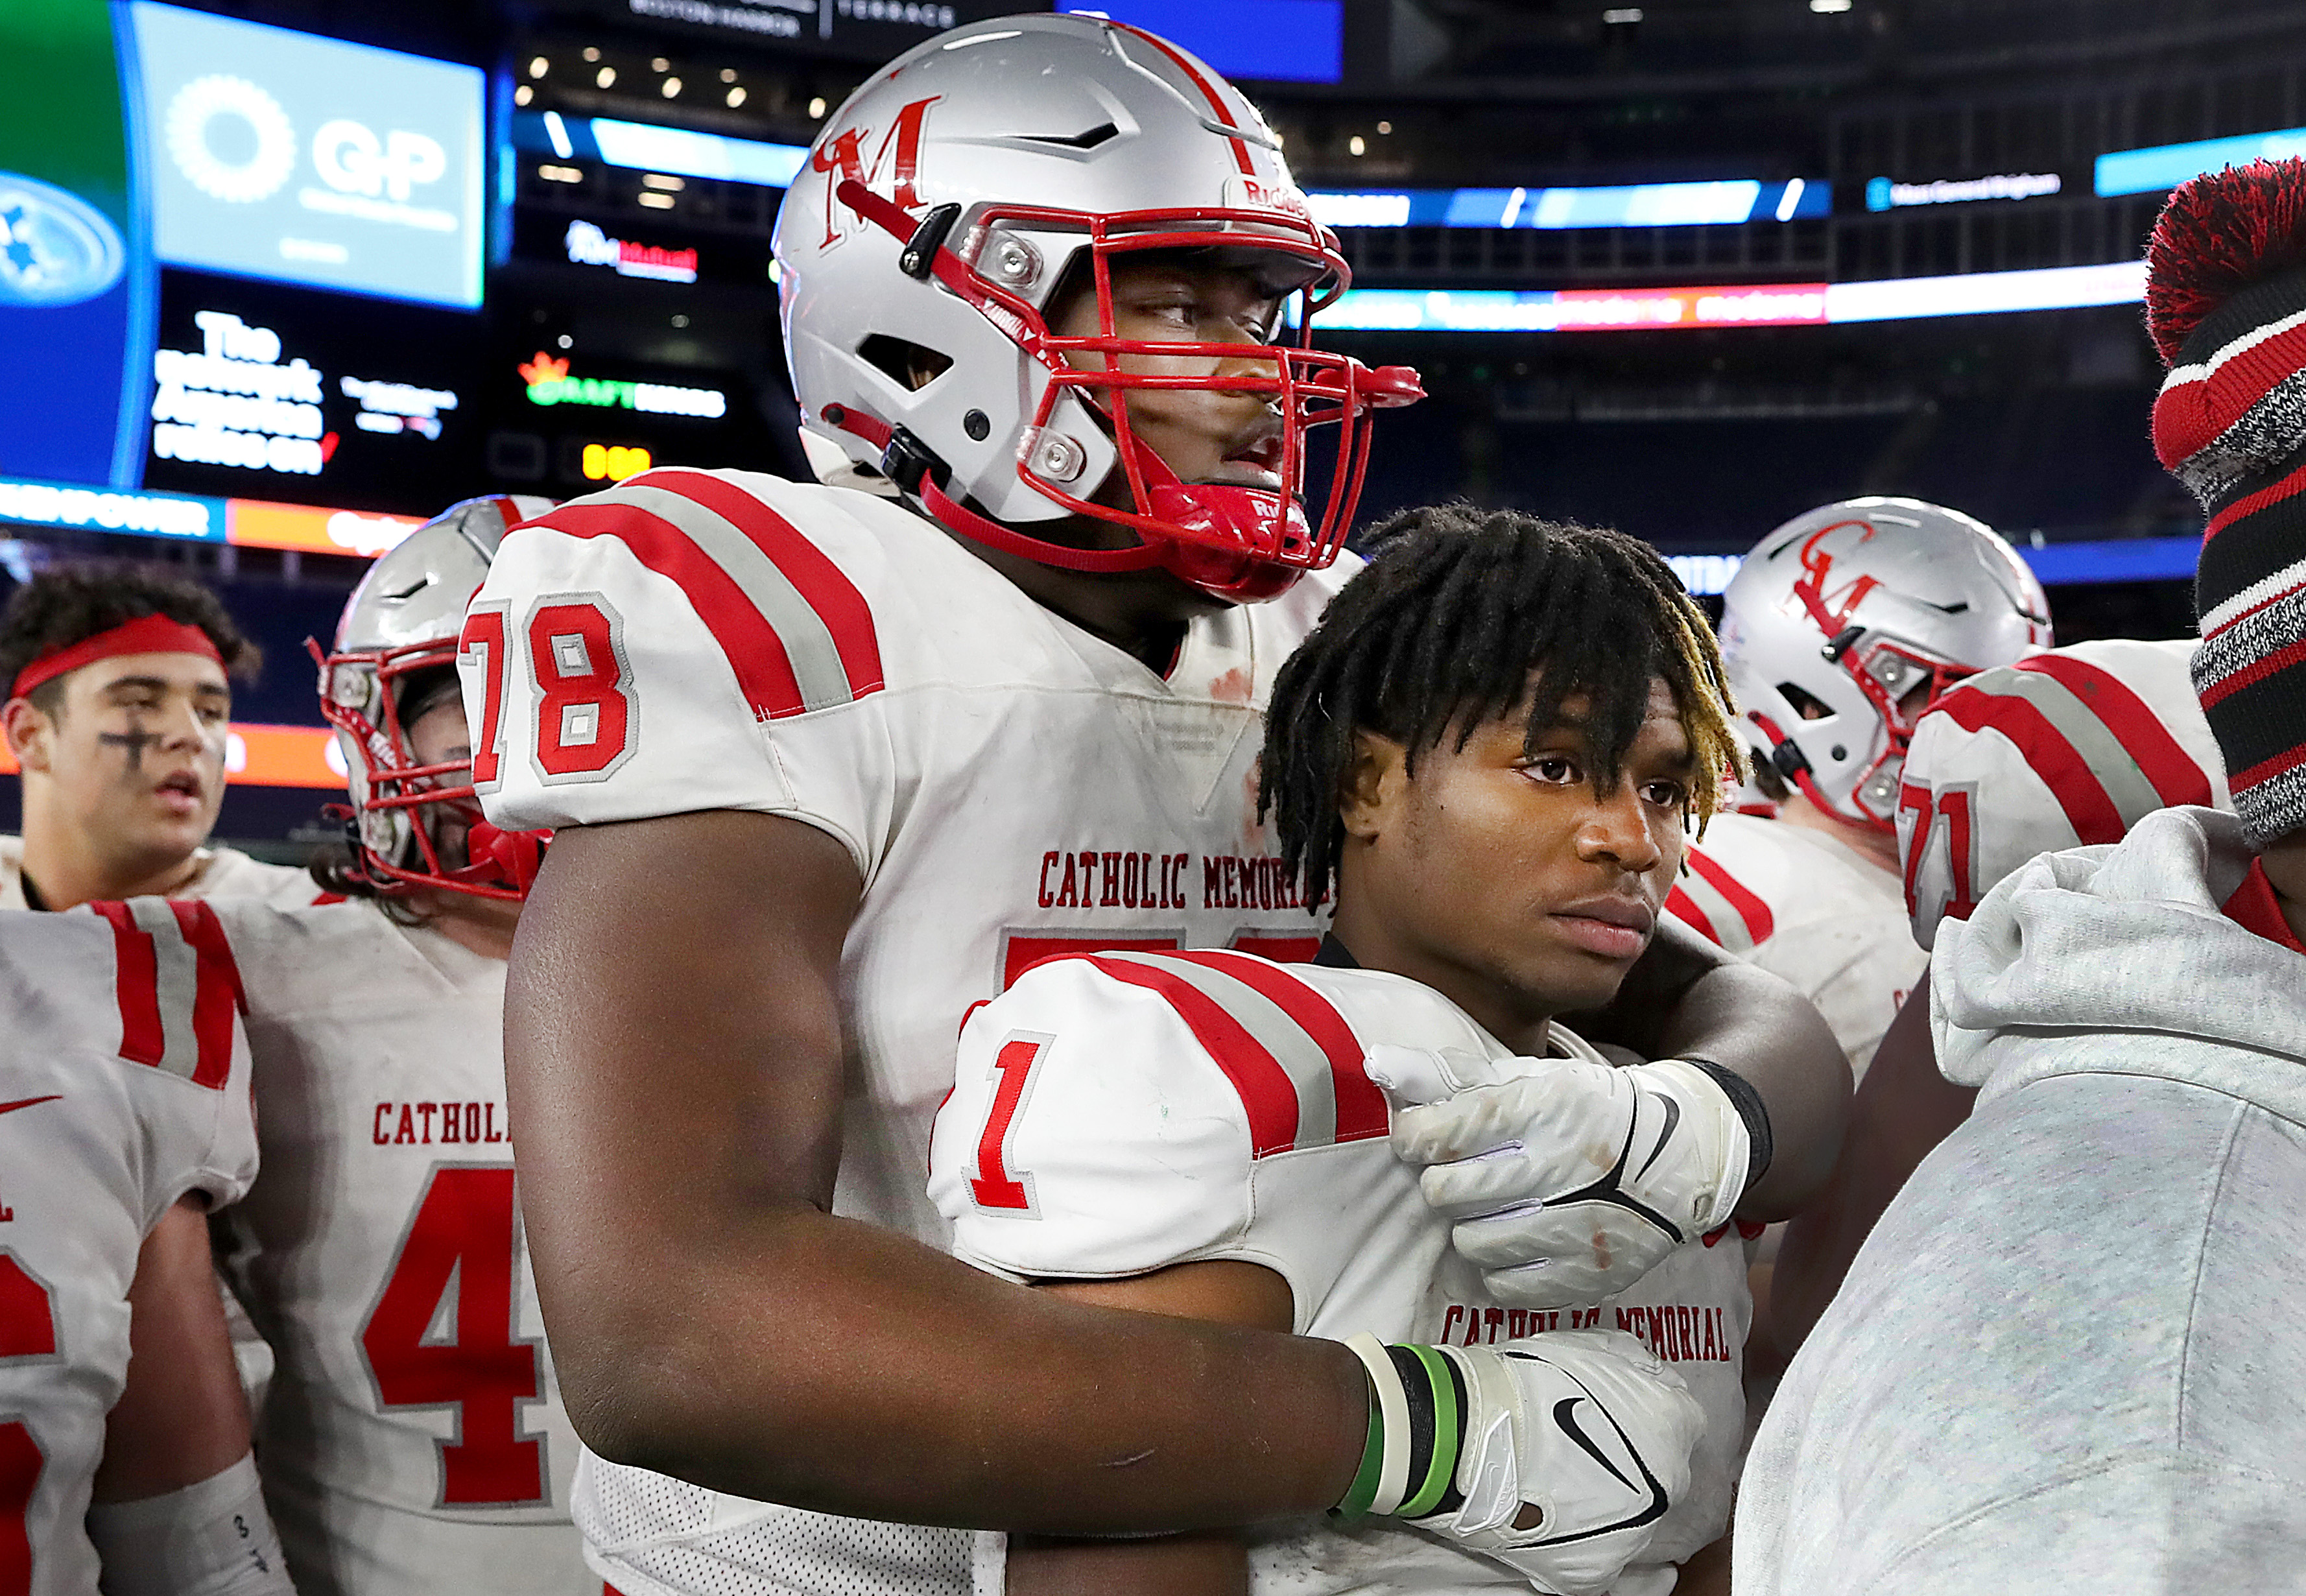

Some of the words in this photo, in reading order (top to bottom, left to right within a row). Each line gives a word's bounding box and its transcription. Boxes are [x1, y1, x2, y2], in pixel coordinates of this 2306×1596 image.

[458, 591, 640, 796] 78
[1038, 850, 1189, 909] CATHOLIC
[1204, 855, 1331, 911] MEMOR
[1896, 776, 1980, 931] 71
[372, 1102, 512, 1147] CATHOL
[961, 1029, 1056, 1220] 1
[358, 1161, 550, 1510] 4
